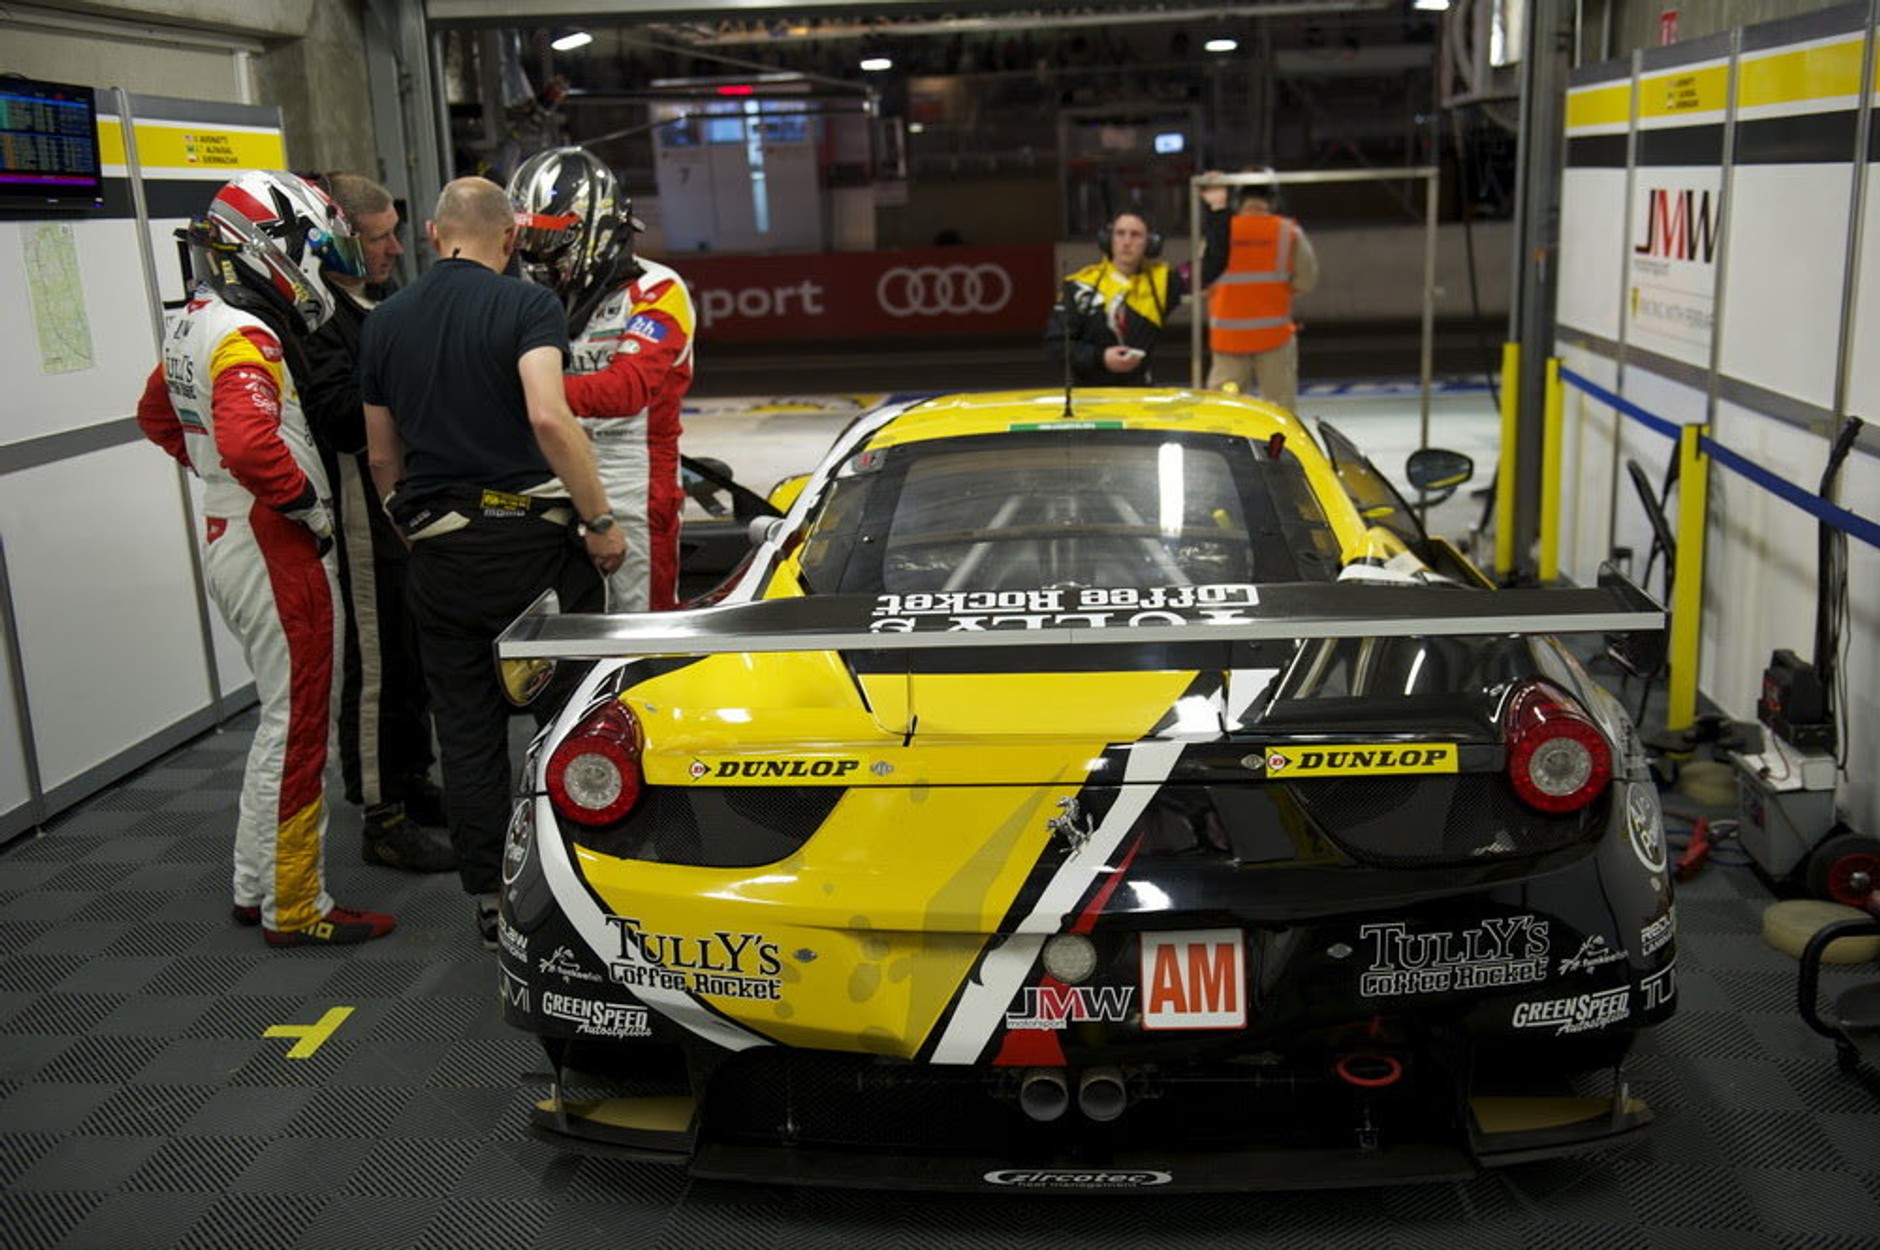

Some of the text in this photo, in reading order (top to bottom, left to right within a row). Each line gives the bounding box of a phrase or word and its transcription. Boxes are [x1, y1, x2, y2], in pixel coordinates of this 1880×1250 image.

[1634, 188, 1721, 264] JMW
[693, 279, 824, 327] port
[872, 584, 1260, 615] Coffee Rocket
[714, 760, 860, 778] DUNLOP
[1297, 750, 1447, 769] DUNLOP
[604, 915, 782, 976] TULLY'S
[1360, 915, 1550, 971] TULLY'S
[610, 962, 687, 992] Coffee
[692, 972, 782, 1000] Rocket
[1149, 943, 1237, 1014] AM
[1360, 969, 1452, 997] Coffee
[1454, 956, 1549, 989] Rocket
[1006, 986, 1135, 1021] JMW
[1007, 1019, 1067, 1031] motorsport
